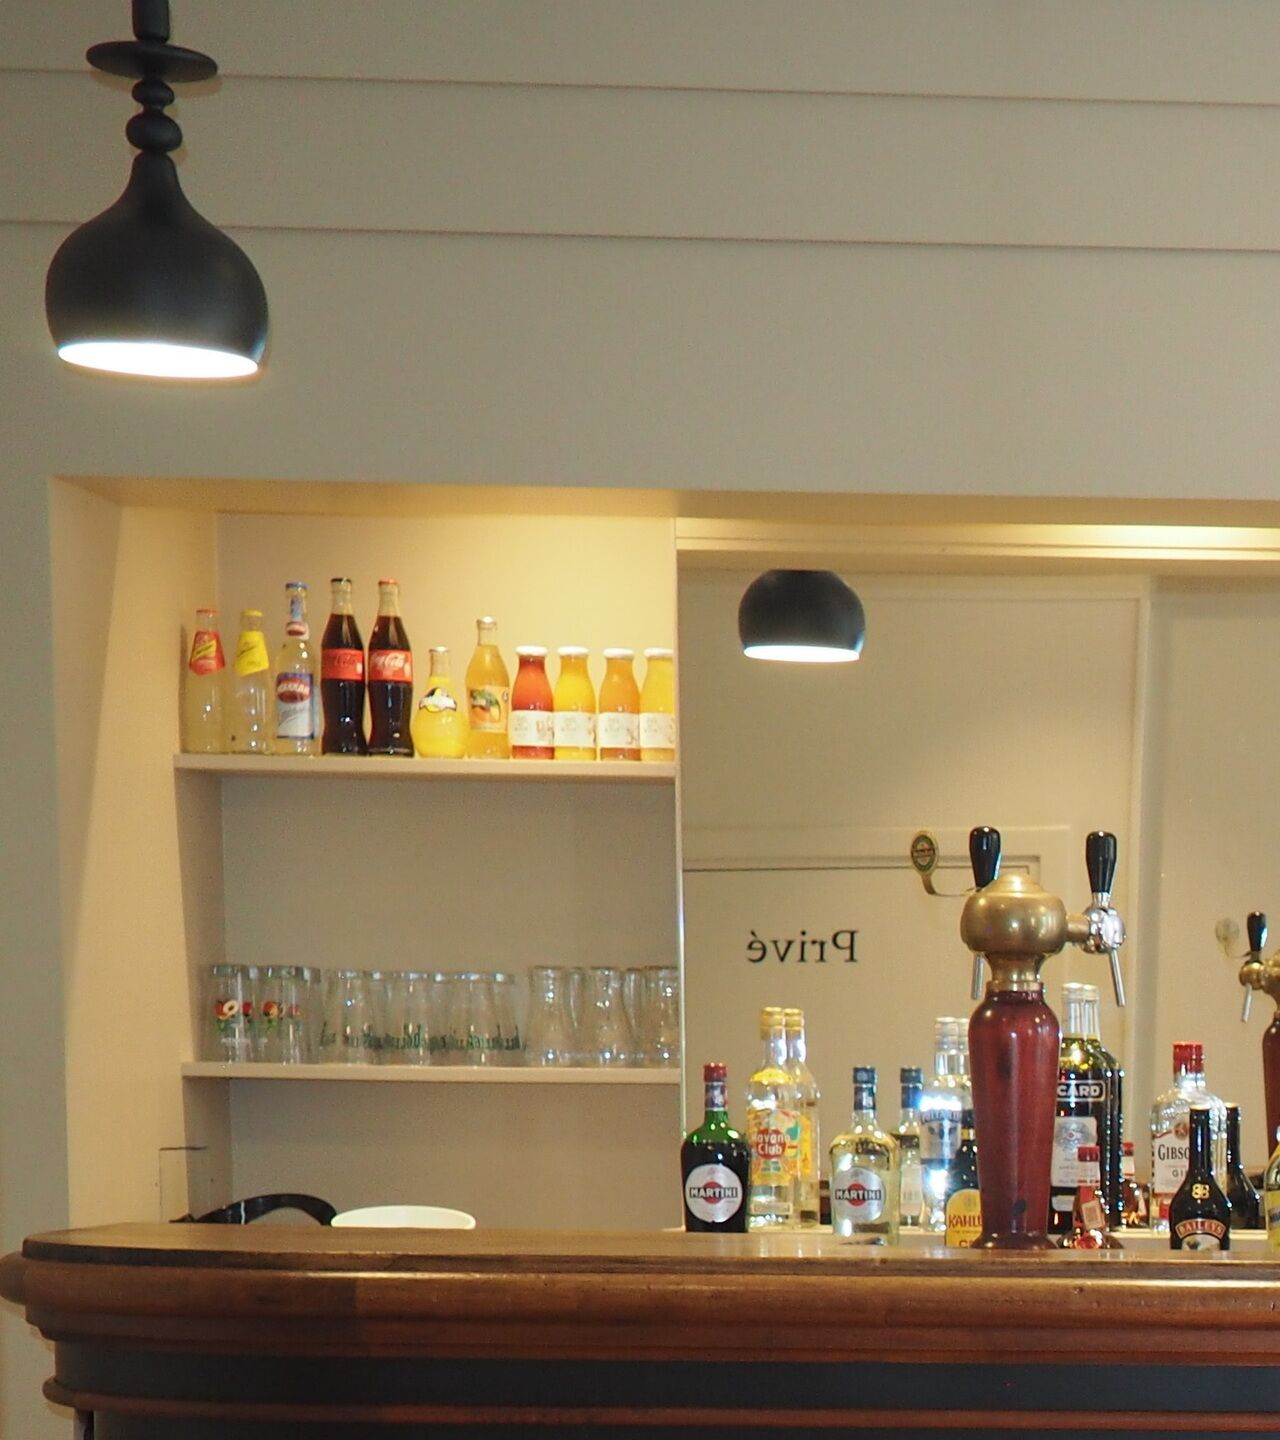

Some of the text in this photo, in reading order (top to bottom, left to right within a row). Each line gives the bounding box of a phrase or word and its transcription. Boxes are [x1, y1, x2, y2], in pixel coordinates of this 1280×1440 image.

[1057, 1085, 1101, 1097] CARD
[758, 1143, 783, 1155] Club
[1158, 1144, 1190, 1161] GIBSO
[1172, 1169, 1188, 1178] GI
[691, 1187, 737, 1198] MARTINI
[836, 1190, 880, 1200] MARTINI
[1179, 1220, 1223, 1236] BAILEYS
